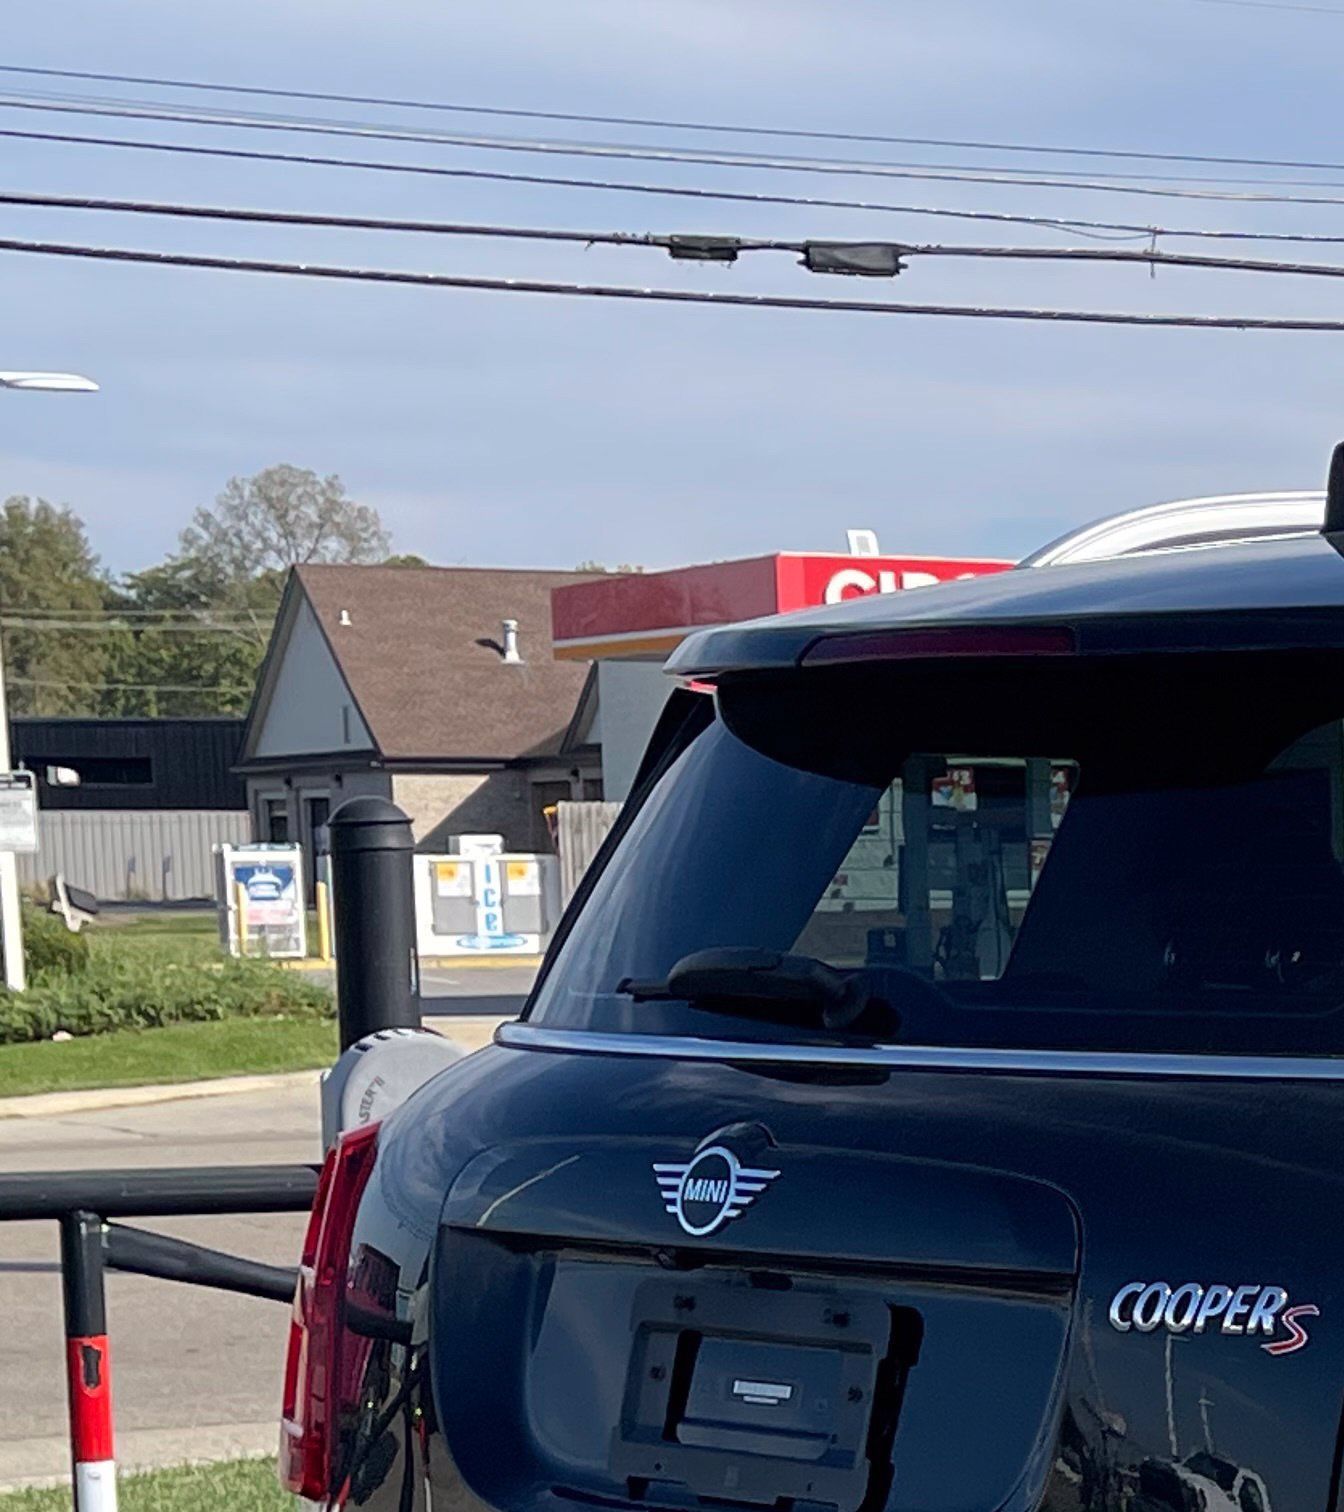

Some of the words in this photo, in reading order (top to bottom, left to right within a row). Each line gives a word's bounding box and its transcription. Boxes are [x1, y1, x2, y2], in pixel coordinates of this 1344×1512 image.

[683, 1178, 728, 1204] MINI
[1108, 1281, 1289, 1336] COOPER
[1260, 1304, 1320, 1356] S
